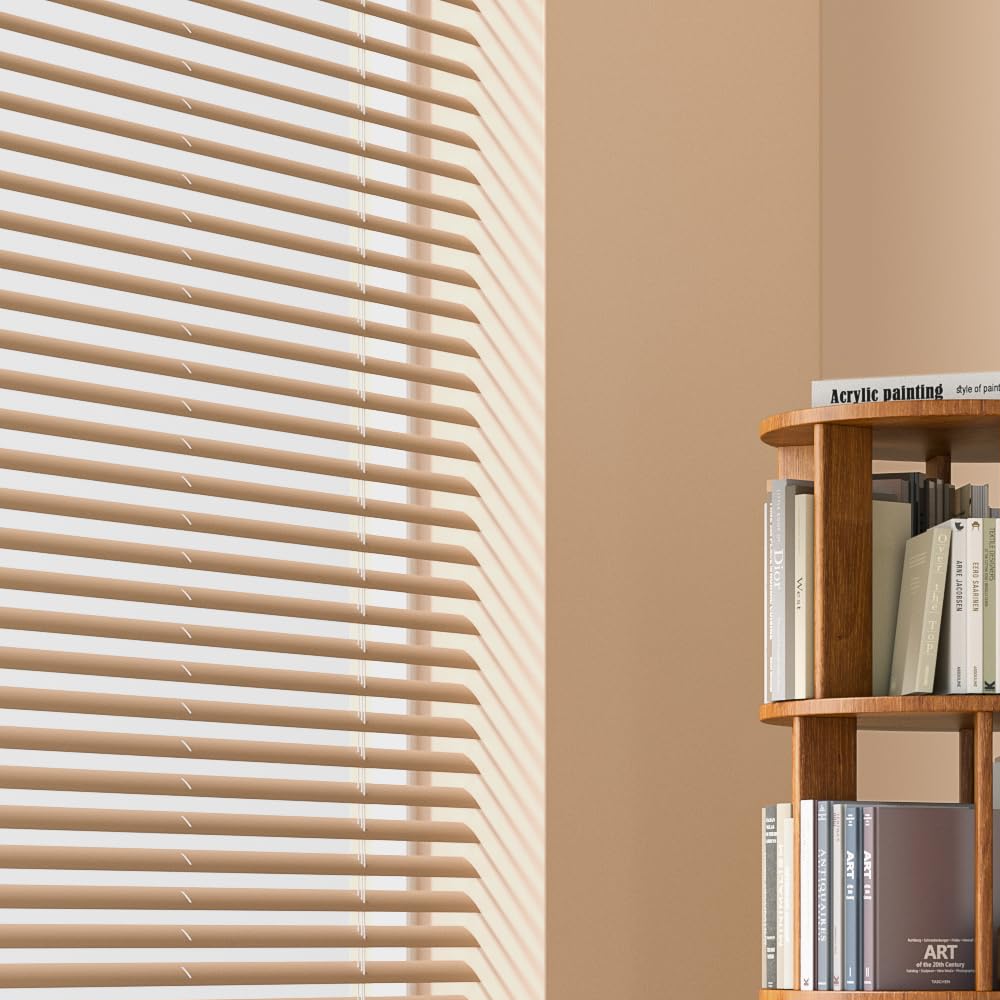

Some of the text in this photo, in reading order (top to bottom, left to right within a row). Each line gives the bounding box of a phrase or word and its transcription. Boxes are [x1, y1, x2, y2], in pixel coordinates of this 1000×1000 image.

[831, 384, 944, 404] Acrylic painting
[956, 385, 972, 395] style
[974, 385, 982, 393] of
[774, 549, 784, 590] Dior
[972, 562, 980, 612] EERO SAARINEN
[847, 850, 855, 880] ART
[864, 850, 872, 880] ART
[819, 849, 828, 943] ANTIQUAIRES
[923, 944, 958, 960] ART
